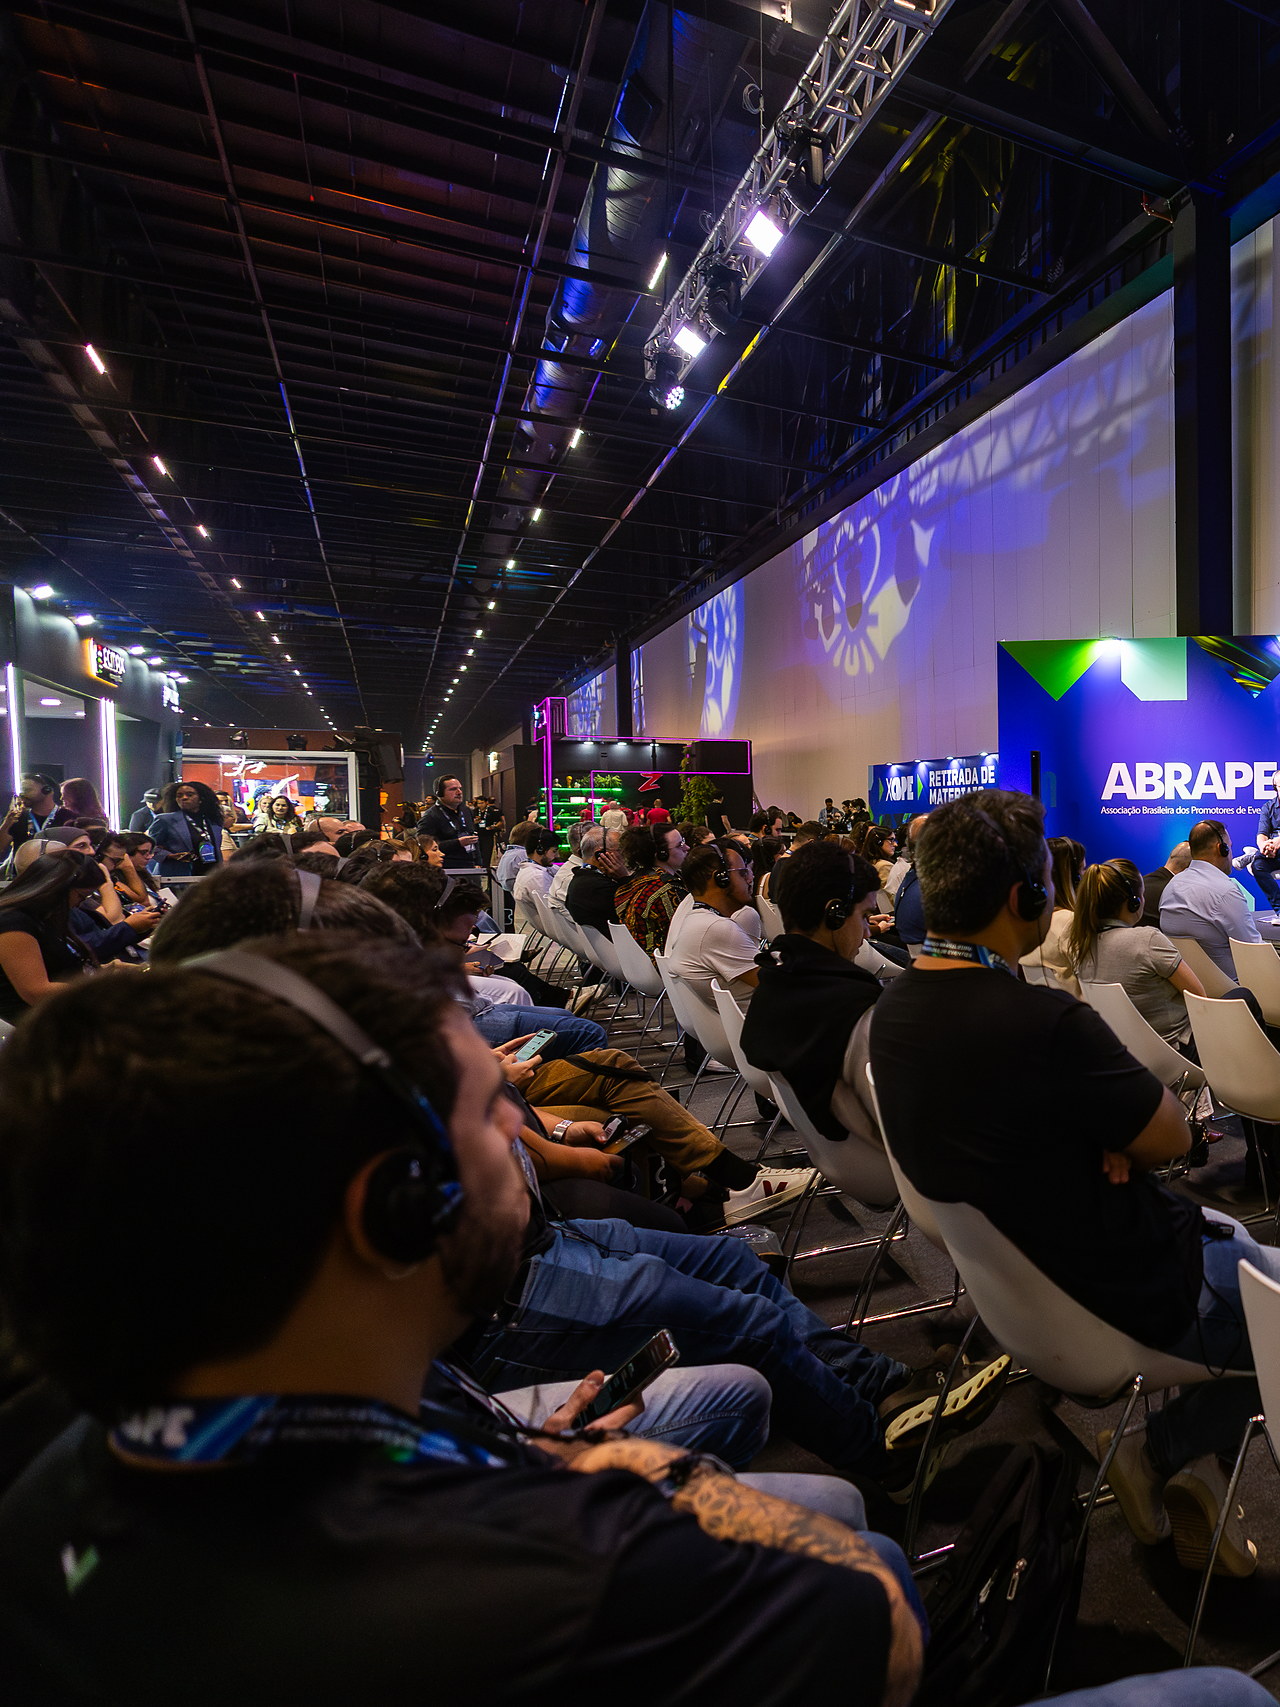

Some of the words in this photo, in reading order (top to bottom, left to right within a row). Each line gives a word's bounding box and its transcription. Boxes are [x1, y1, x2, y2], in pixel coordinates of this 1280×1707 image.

[929, 767, 979, 787] RETIRADA
[981, 765, 996, 784] DE
[1101, 762, 1278, 800] ABRAPE
[930, 786, 984, 805] MATERI
[1100, 806, 1141, 816] Associação
[1142, 806, 1174, 815] Brasileira
[1175, 806, 1190, 815] dos
[1191, 806, 1234, 815] Promotores
[1235, 806, 1246, 815] de
